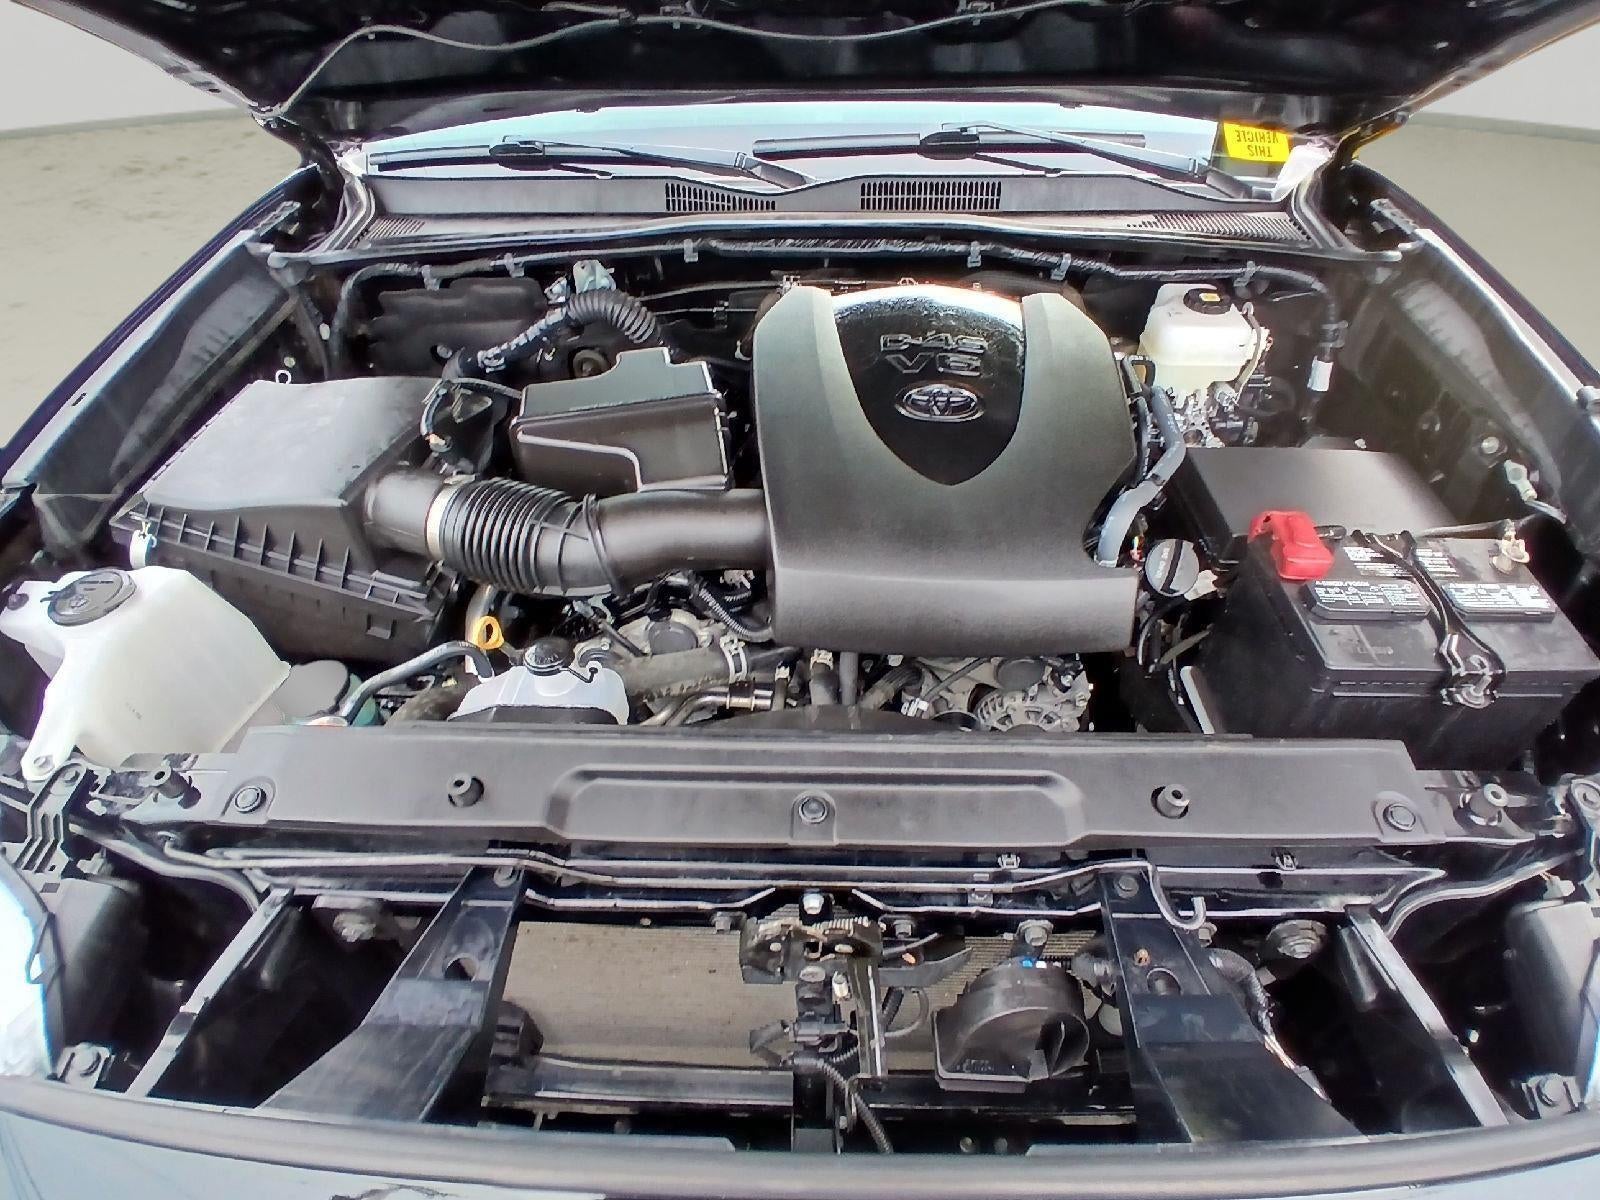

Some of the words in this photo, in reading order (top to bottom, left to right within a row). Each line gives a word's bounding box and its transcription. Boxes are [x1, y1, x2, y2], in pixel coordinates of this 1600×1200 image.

[1234, 129, 1279, 144] VEHICLE
[1247, 144, 1273, 158] THIS
[884, 352, 982, 377] V6
